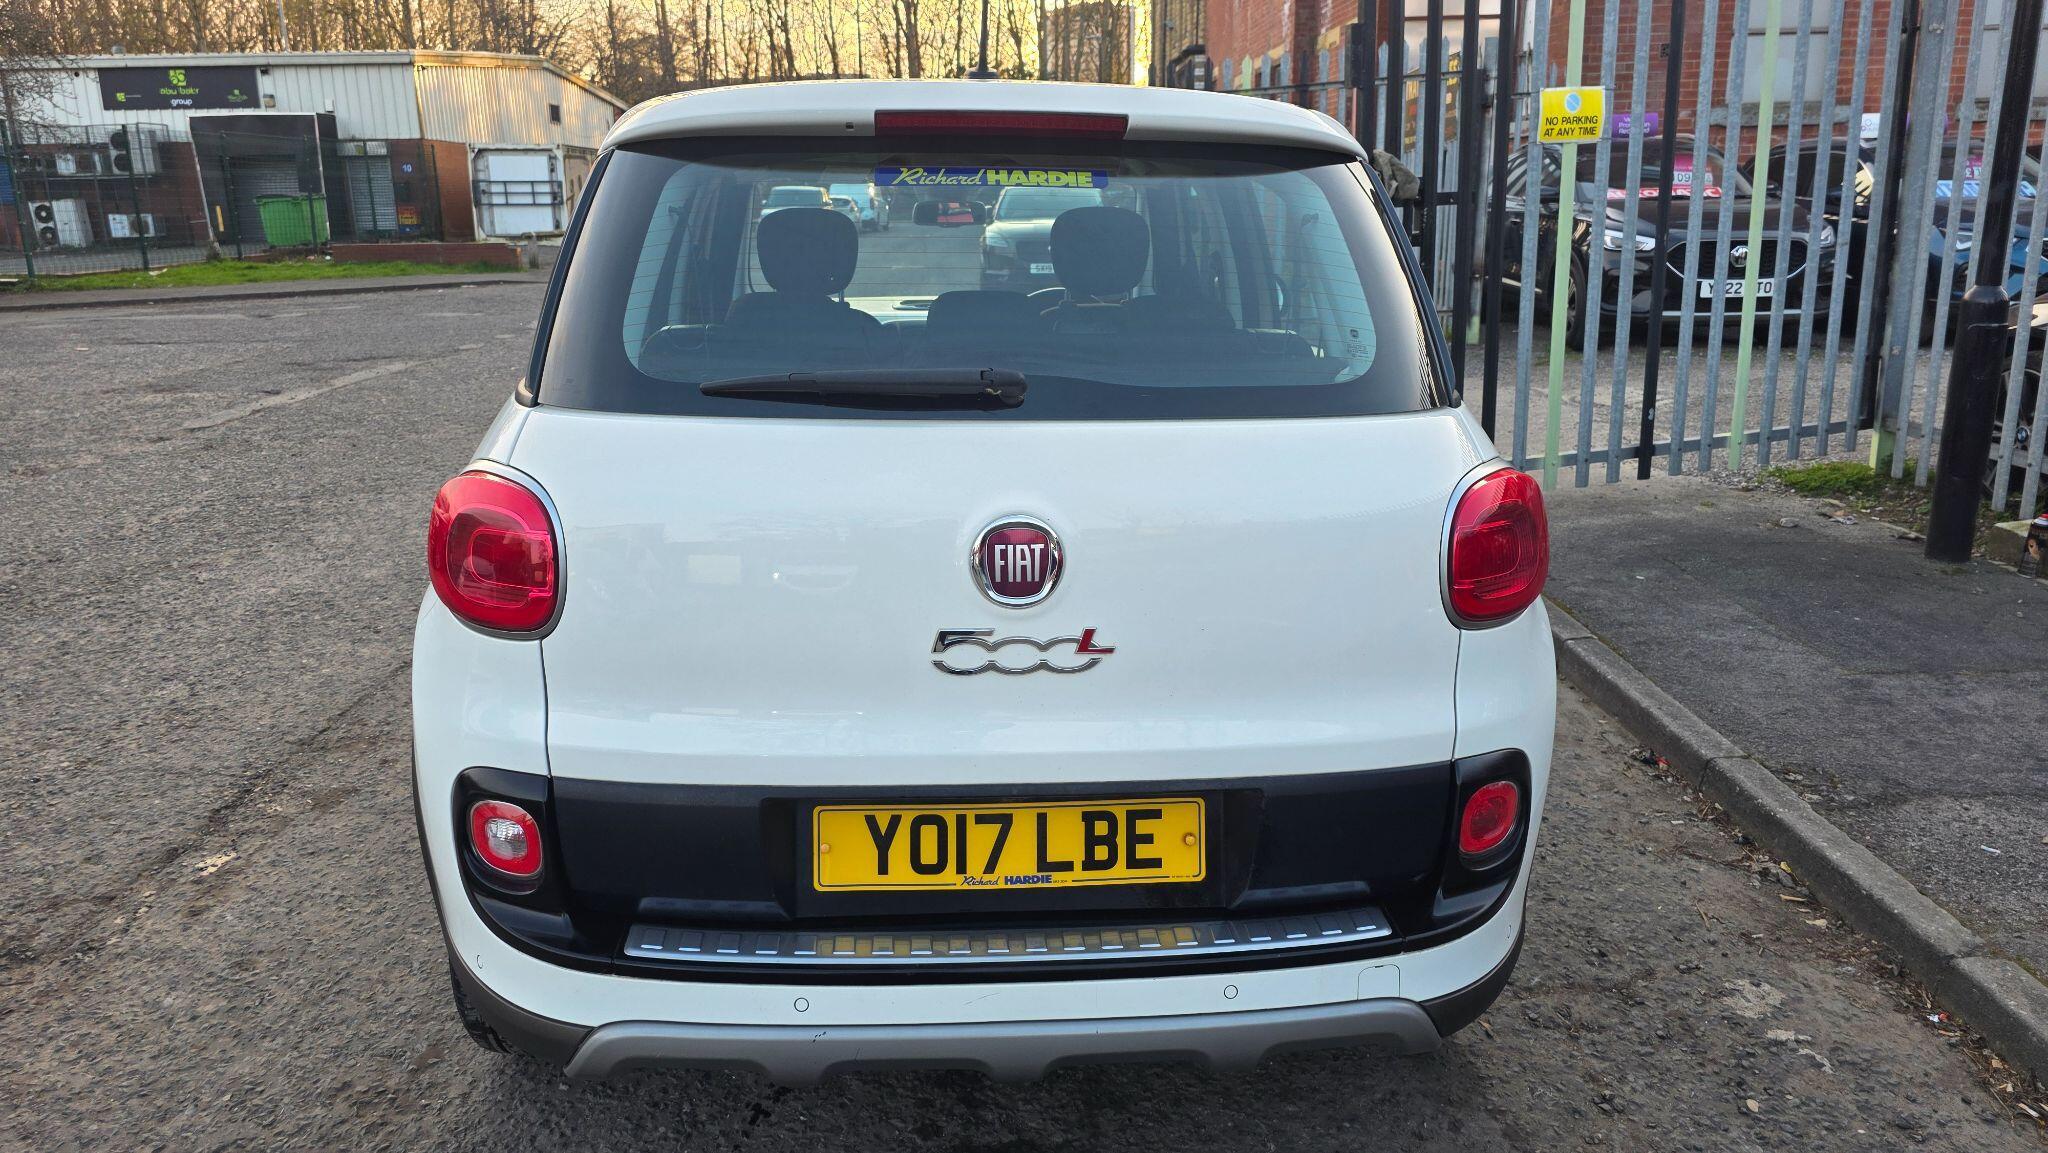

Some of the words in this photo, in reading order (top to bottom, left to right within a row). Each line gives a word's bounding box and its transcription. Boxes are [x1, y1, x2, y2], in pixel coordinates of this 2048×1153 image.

[170, 98, 193, 107] group
[1545, 116, 1559, 126] NO
[1561, 115, 1598, 125] PARKING
[1544, 128, 1554, 137] AT
[1556, 127, 1575, 136] ANY
[1579, 126, 1597, 135] TIME
[402, 164, 412, 173] 10
[892, 168, 984, 186] Richard
[986, 170, 1093, 187] HARDIE
[1708, 283, 1743, 294] Y22
[1752, 282, 1773, 293] TO
[994, 543, 1045, 582] FIAT
[931, 627, 1116, 674] 500L
[1036, 808, 1163, 872] LBE
[960, 875, 1000, 886] Richard
[1004, 874, 1053, 885] HARDIE
